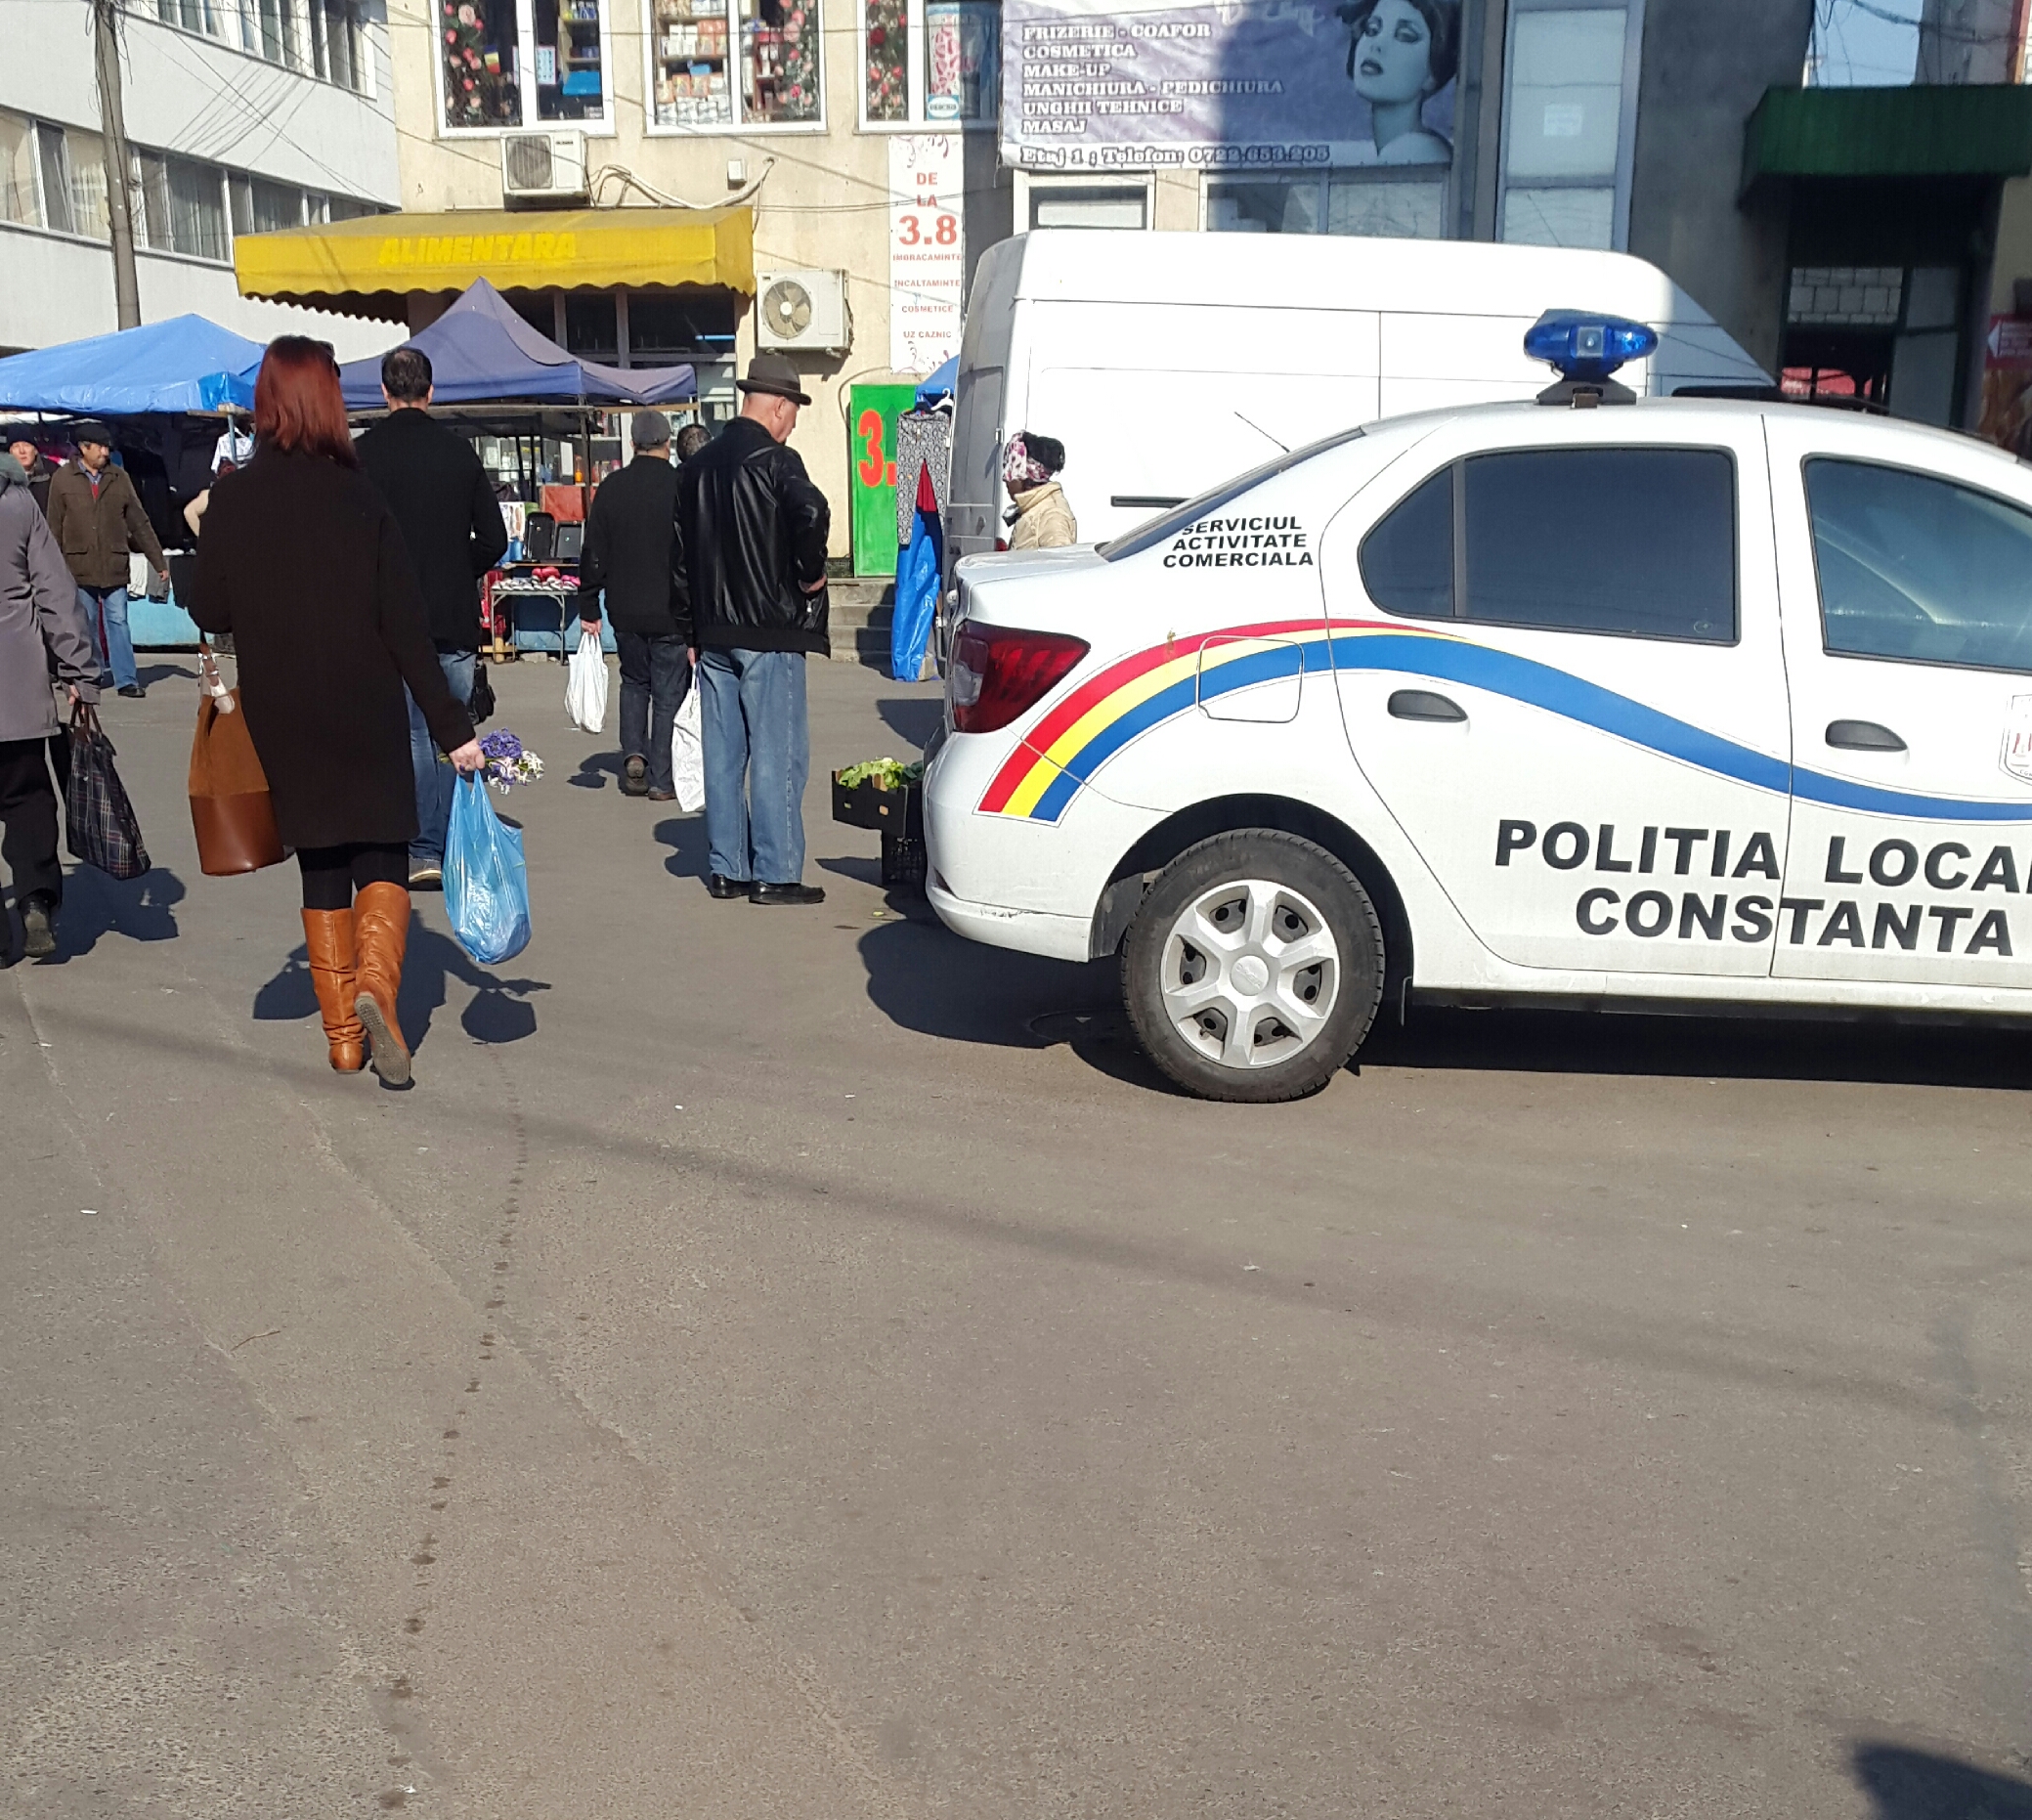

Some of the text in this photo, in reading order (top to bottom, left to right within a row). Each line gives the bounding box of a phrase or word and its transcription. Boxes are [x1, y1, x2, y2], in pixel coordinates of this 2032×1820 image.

[1022, 24, 1115, 40] FRIZERIE
[1131, 22, 1211, 38] COAFOR
[1022, 43, 1138, 60] COSMETICA
[1022, 62, 1111, 78] MAKE-UP
[1022, 80, 1146, 97] MANICHIURA
[1161, 80, 1284, 95] PEDICHIURA
[1022, 99, 1183, 115] UNGHII TEHNICE
[1021, 118, 1087, 134] MASAJ
[1020, 146, 1065, 167] Etaj
[1071, 148, 1084, 163] 1
[917, 171, 937, 186] DE
[917, 195, 937, 207] LA
[898, 214, 957, 245] 3.8
[378, 232, 577, 266] ALIMENTARA
[901, 305, 954, 314] COSMETICE
[858, 409, 912, 487] 3.
[1182, 516, 1302, 535] SERVICIUL
[1172, 534, 1307, 551] ACTIVITATE
[1163, 552, 1314, 568] COMERCIALA
[1494, 819, 2032, 894] POLITIA LOCA
[1576, 888, 2013, 957] CONSTANTA
